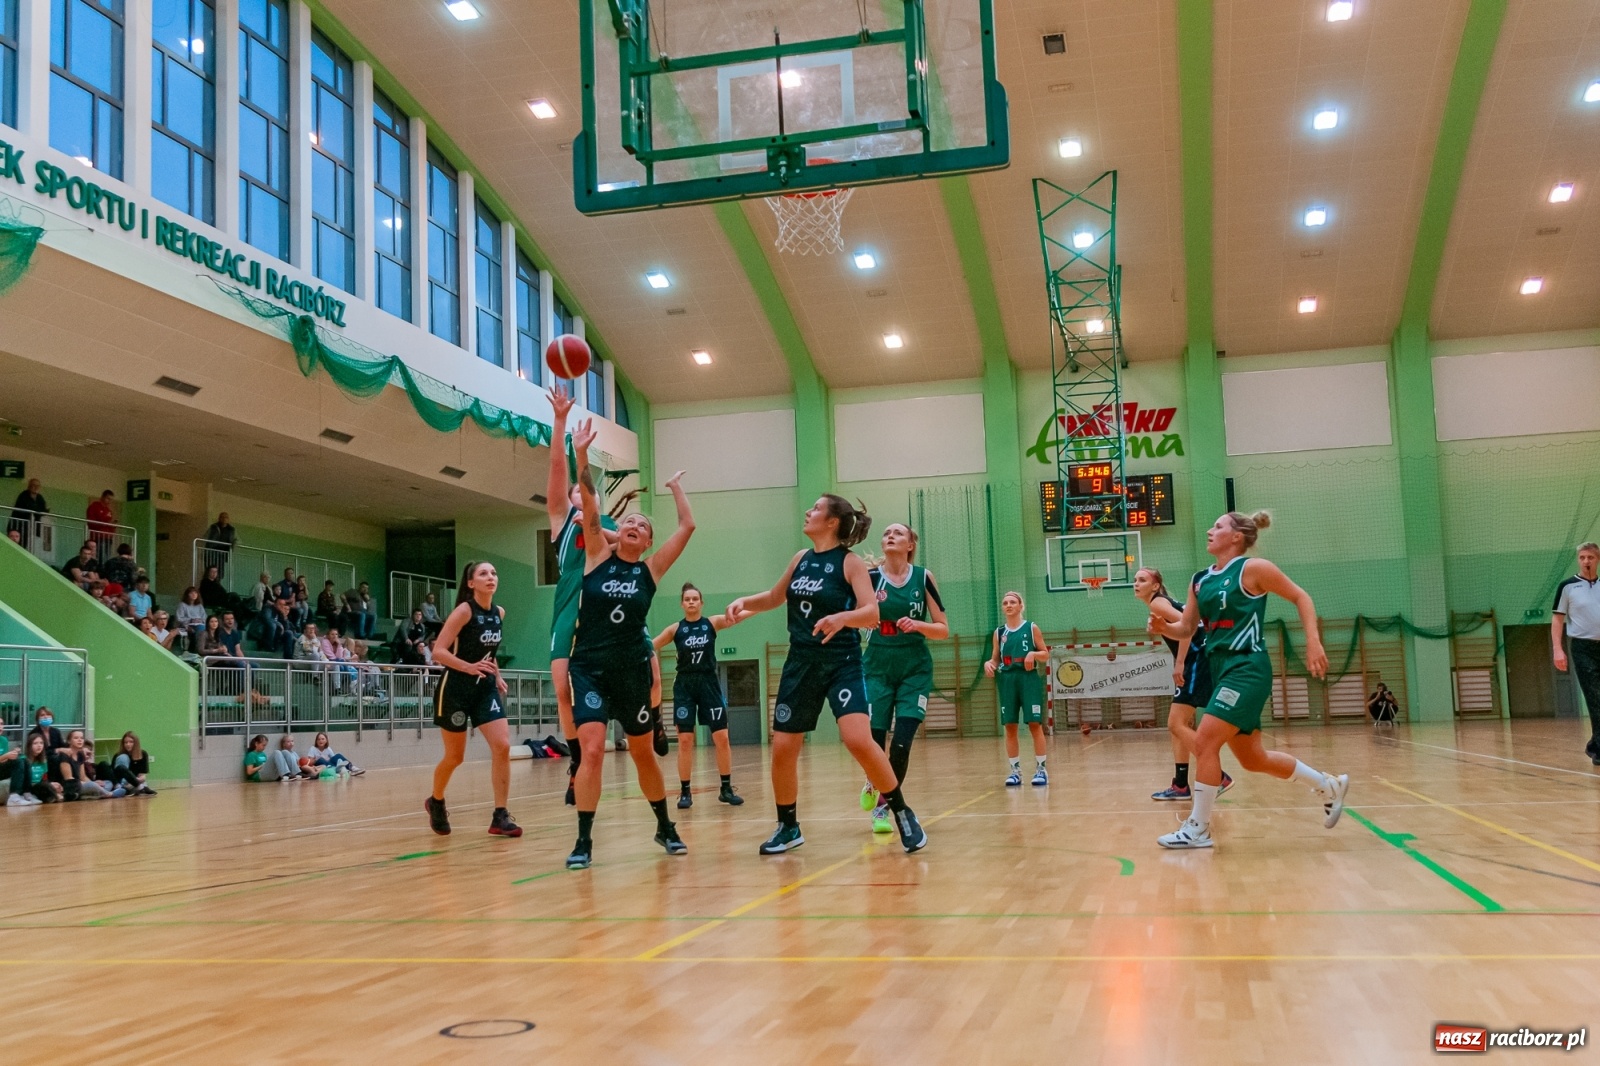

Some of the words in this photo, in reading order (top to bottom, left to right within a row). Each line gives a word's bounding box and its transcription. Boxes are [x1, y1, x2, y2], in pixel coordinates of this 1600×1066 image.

[34, 160, 136, 231] SPORTU
[141, 208, 149, 239] I
[155, 215, 262, 290] REKREACJI
[266, 267, 347, 328] RACIBÓRZ
[4, 466, 18, 477] F
[132, 486, 145, 498] F
[1092, 478, 1102, 492] 9
[1075, 514, 1092, 527] 52
[1129, 511, 1147, 524] 35
[1218, 590, 1227, 610] 3
[609, 604, 625, 624] 6
[799, 600, 812, 618] 9
[909, 601, 924, 618] 24
[1022, 640, 1029, 652] 5
[690, 651, 704, 665] 17
[1089, 678, 1109, 692] JEST
[1109, 675, 1118, 684] W
[838, 688, 852, 707] 9
[489, 699, 501, 712] 4
[637, 704, 650, 724] 6
[709, 706, 723, 720] 17
